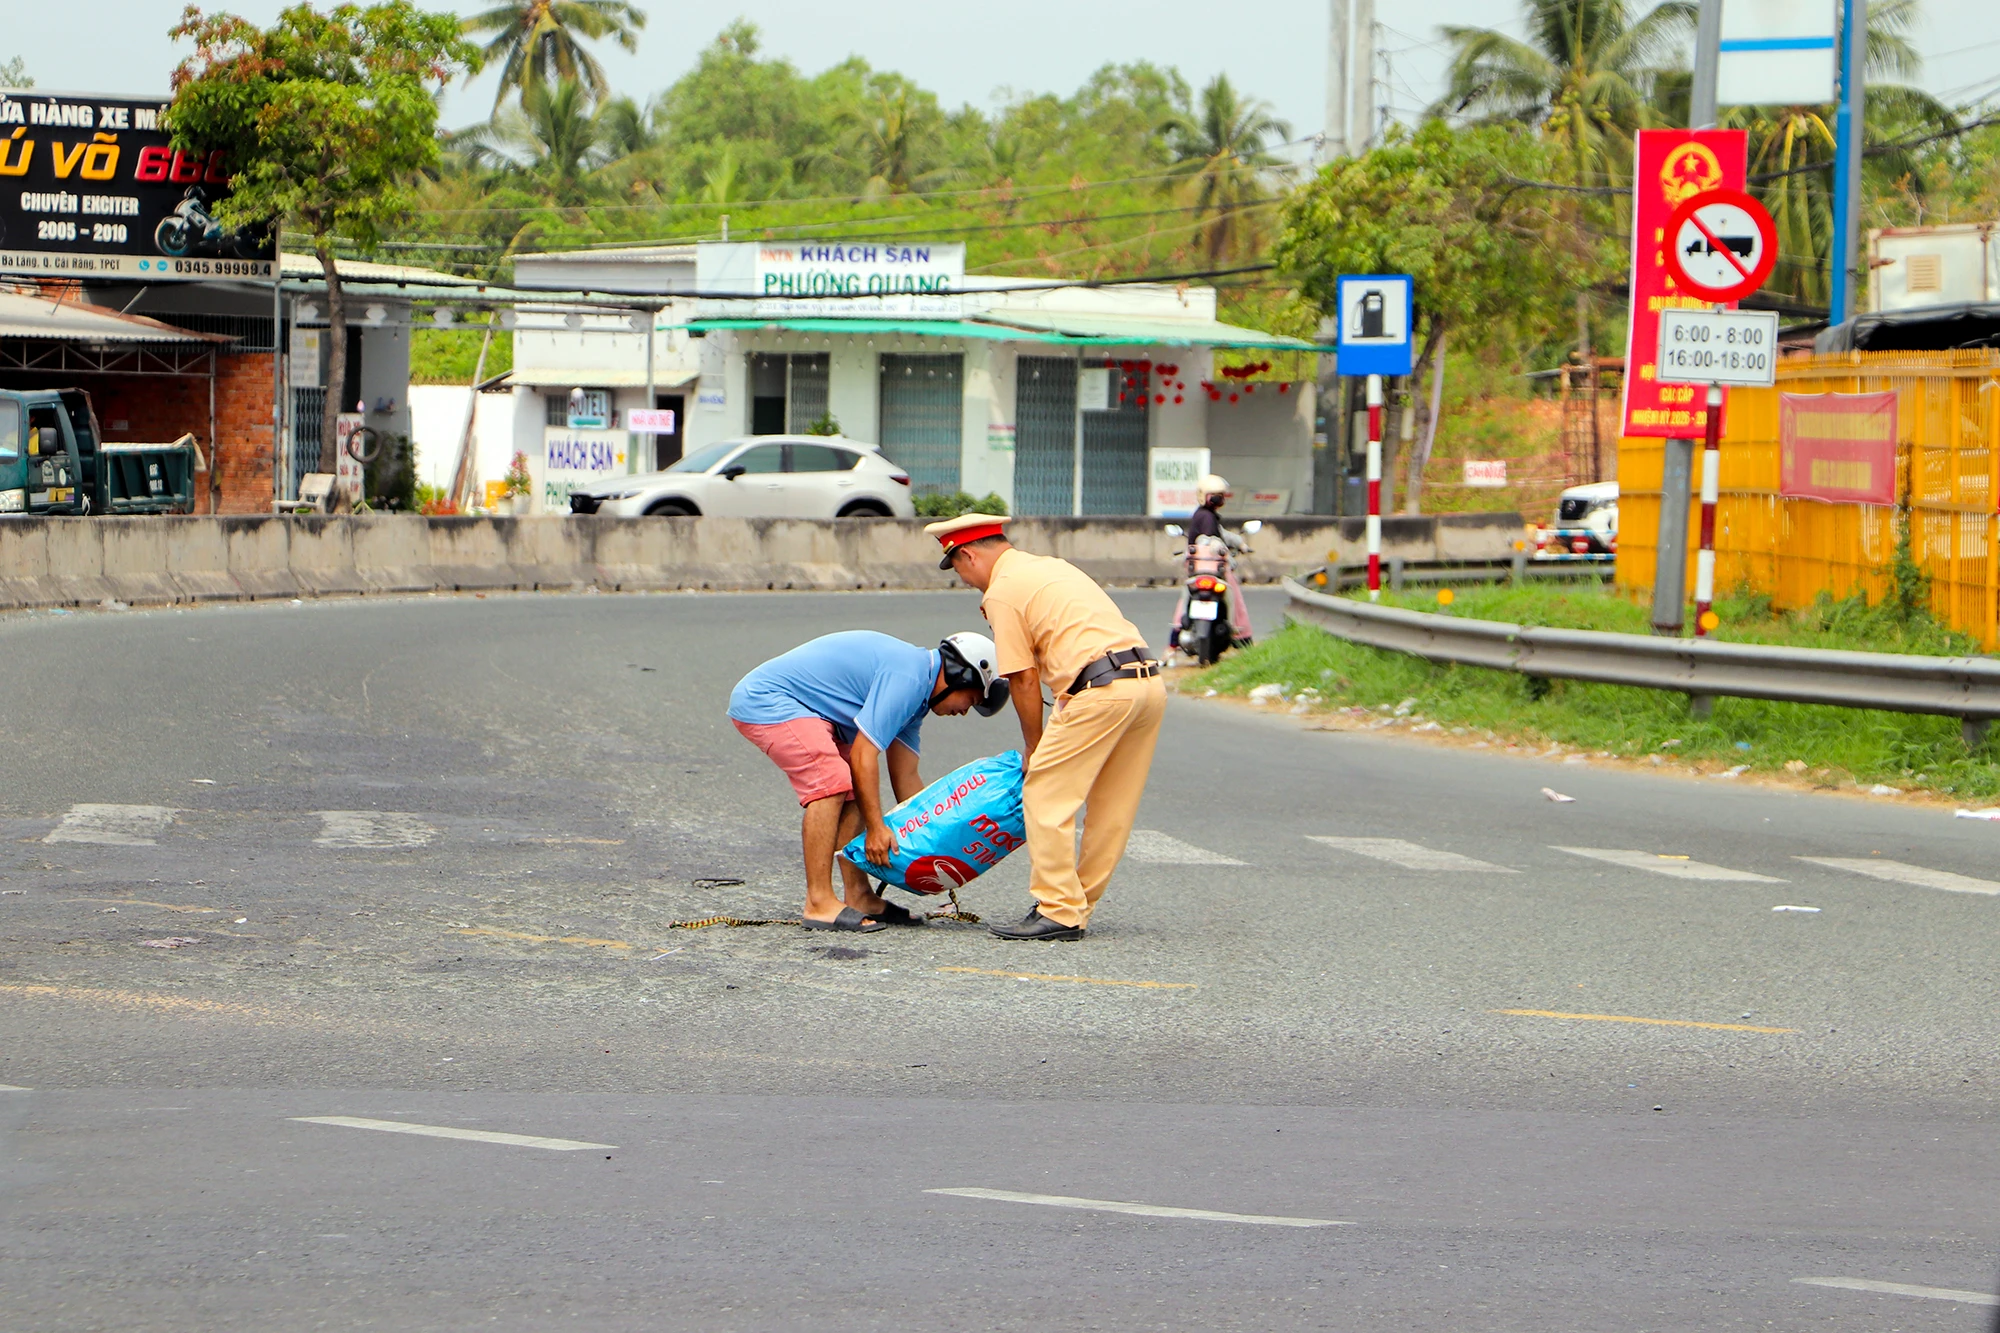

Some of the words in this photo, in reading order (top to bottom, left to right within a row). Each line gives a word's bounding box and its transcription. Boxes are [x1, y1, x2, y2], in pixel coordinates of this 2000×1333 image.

[30, 97, 94, 128] HÀNG
[100, 106, 130, 129] XE
[52, 132, 120, 180] VÕ
[20, 191, 78, 214] CHUYÊN
[82, 195, 140, 216] EXCITER
[37, 220, 77, 241] 2005
[93, 223, 128, 243] 2010
[2, 254, 14, 266] Ba
[100, 259, 120, 270] TPCT
[801, 243, 877, 263] KHÁCH
[885, 246, 930, 267] SẠN
[175, 260, 271, 276] 0345.99999.4
[764, 268, 861, 295] PHƯƠNG
[1674, 325, 1710, 343] 6:00
[1726, 327, 1763, 345] 8:00
[1667, 349, 1766, 370] 16:00-18:00
[1695, 411, 1708, 425] 20
[549, 434, 588, 470] KHÁCH
[590, 441, 613, 475] SẠN
[934, 774, 987, 816] makro
[898, 810, 930, 839] 5104
